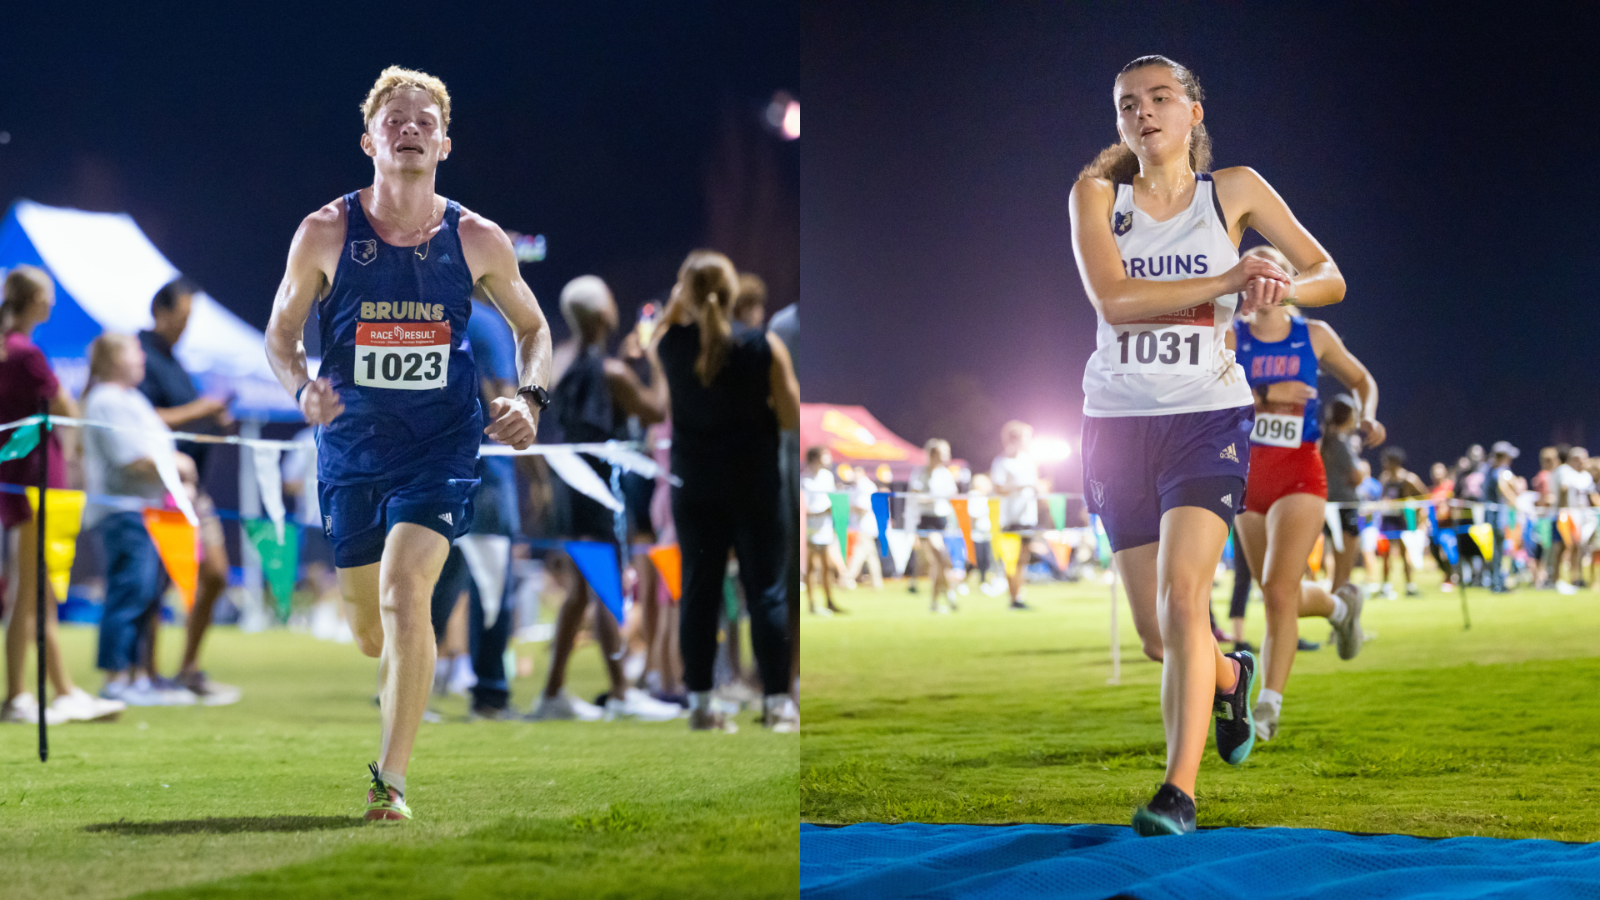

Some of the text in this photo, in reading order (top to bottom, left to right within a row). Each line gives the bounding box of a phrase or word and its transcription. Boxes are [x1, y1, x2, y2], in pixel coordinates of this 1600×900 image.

[360, 301, 445, 321] BRUINS
[370, 330, 436, 340] RACE RESULT
[1117, 331, 1200, 365] 1031
[362, 352, 442, 381] 1023
